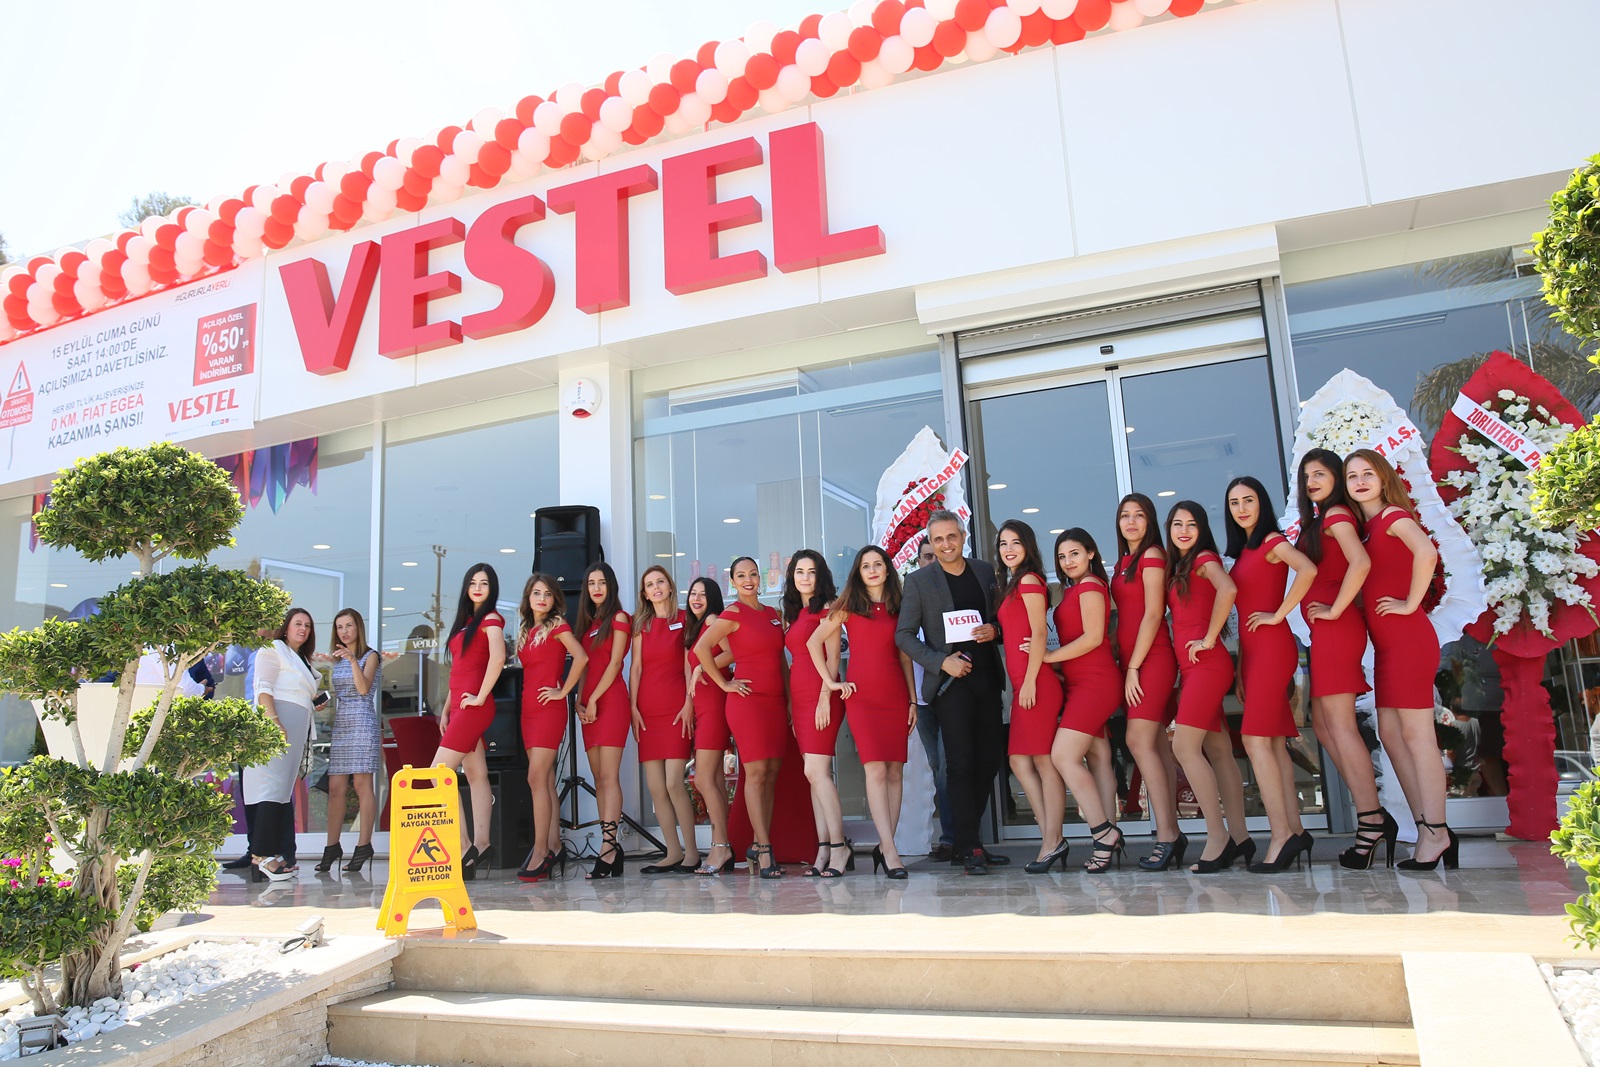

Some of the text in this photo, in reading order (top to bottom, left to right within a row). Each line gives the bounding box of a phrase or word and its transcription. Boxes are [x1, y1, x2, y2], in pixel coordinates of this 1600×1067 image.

[279, 121, 886, 376] VESTEL
[52, 312, 161, 359] 15 EYLÜL CUMA GÜNÜ
[67, 351, 93, 370] SAAT
[208, 354, 235, 368] VARAN
[51, 418, 58, 432] 0
[82, 402, 107, 422] FIAT
[110, 393, 144, 415] EGEA
[167, 388, 239, 423] VESTEL
[48, 423, 101, 450] KAZANMA
[1466, 407, 1525, 452] ZORLUTEKS
[881, 495, 919, 547] CEYLAN
[948, 615, 980, 625] VESTEL
[401, 820, 430, 828] KAYGAN
[407, 865, 452, 876] CAUTION
[409, 872, 450, 883] WET FLOOR
